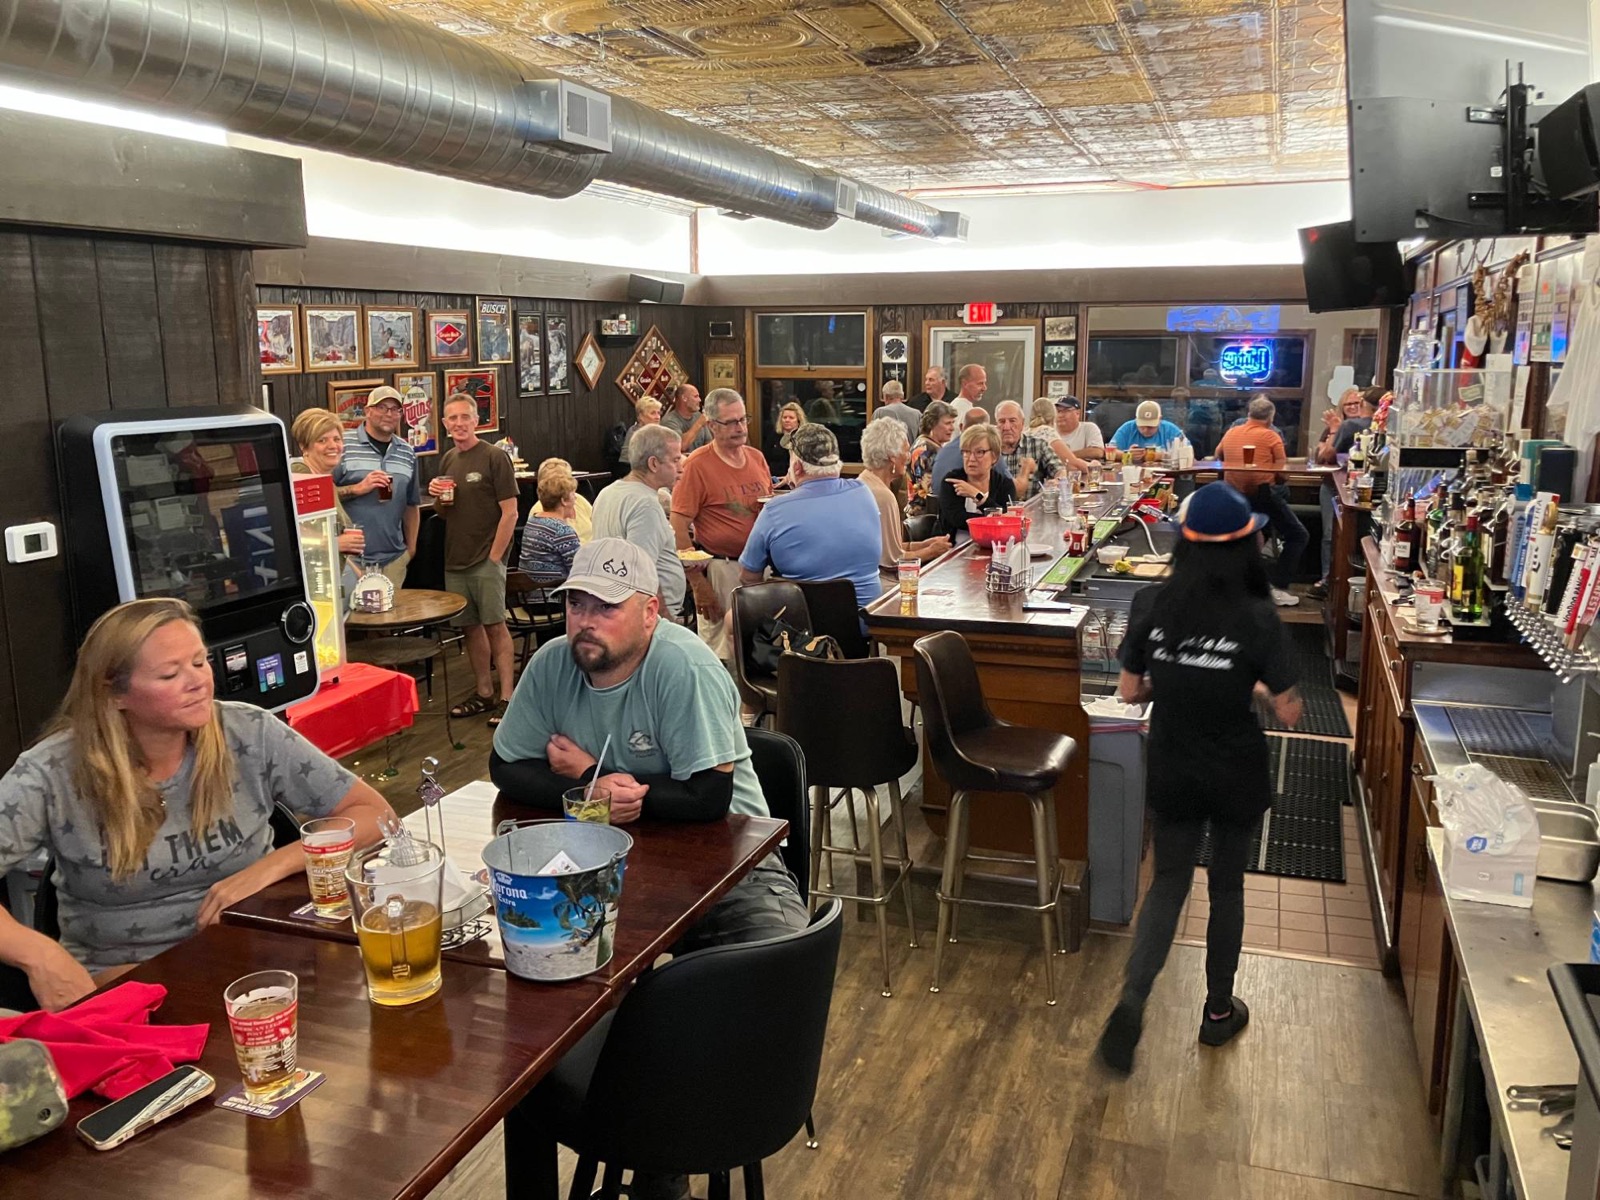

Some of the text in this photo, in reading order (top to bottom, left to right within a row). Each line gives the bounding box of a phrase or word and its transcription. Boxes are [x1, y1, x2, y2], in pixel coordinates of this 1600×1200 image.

[481, 303, 507, 314] BUSCH
[971, 304, 992, 322] EXIT
[402, 400, 431, 426] Twins
